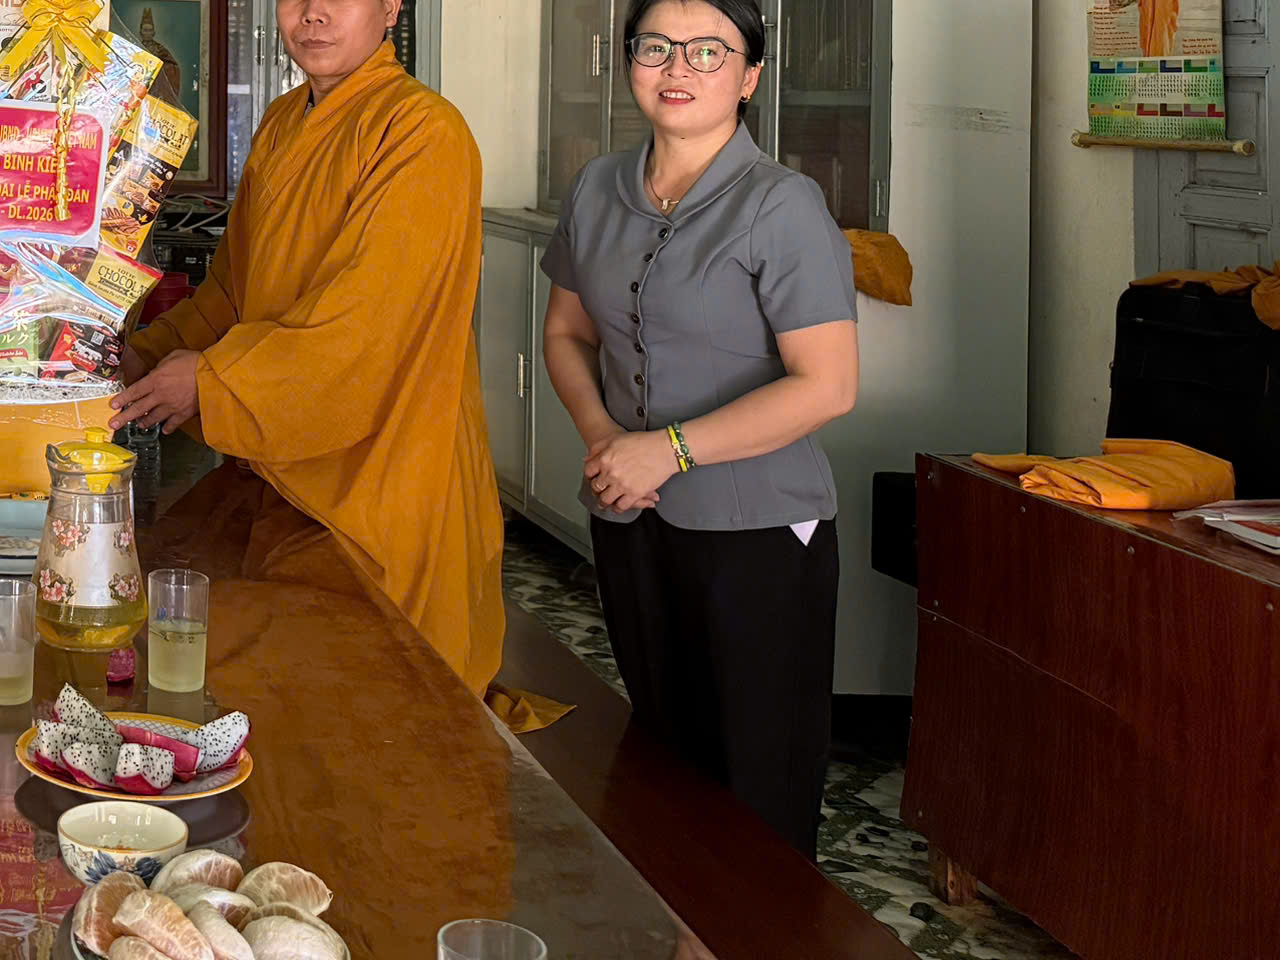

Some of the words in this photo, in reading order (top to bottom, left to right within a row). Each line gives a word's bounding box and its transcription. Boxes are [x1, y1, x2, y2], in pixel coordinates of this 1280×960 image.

[17, 179, 31, 199] LỄ
[33, 182, 57, 205] PHẬ
[66, 183, 90, 204] ĐẢN
[8, 203, 53, 222] DL.2026
